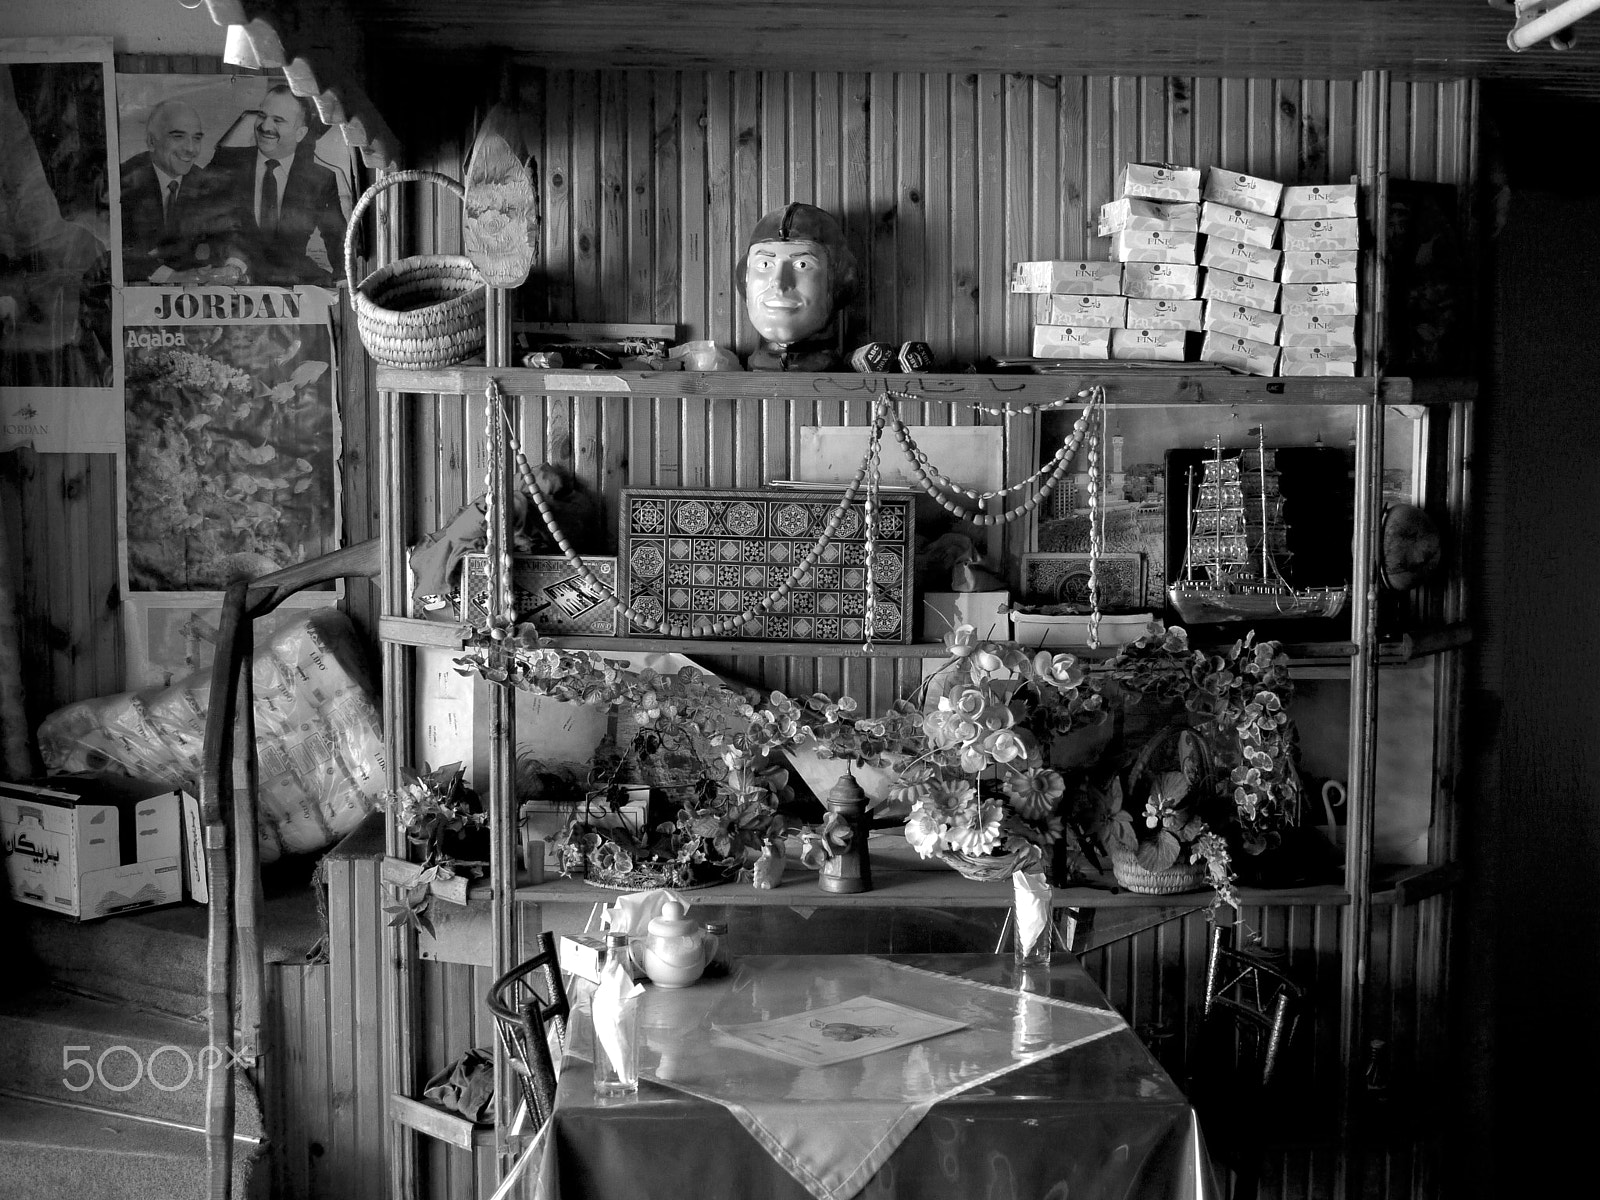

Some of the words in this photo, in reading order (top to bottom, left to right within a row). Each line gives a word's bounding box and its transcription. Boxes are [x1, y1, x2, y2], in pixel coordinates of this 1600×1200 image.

[153, 293, 303, 320] JORDAN
[126, 329, 186, 349] Aqaba
[867, 344, 879, 361] ABC
[907, 353, 919, 368] ABC
[3, 424, 48, 435] JORDAN
[309, 651, 327, 672] LIDO
